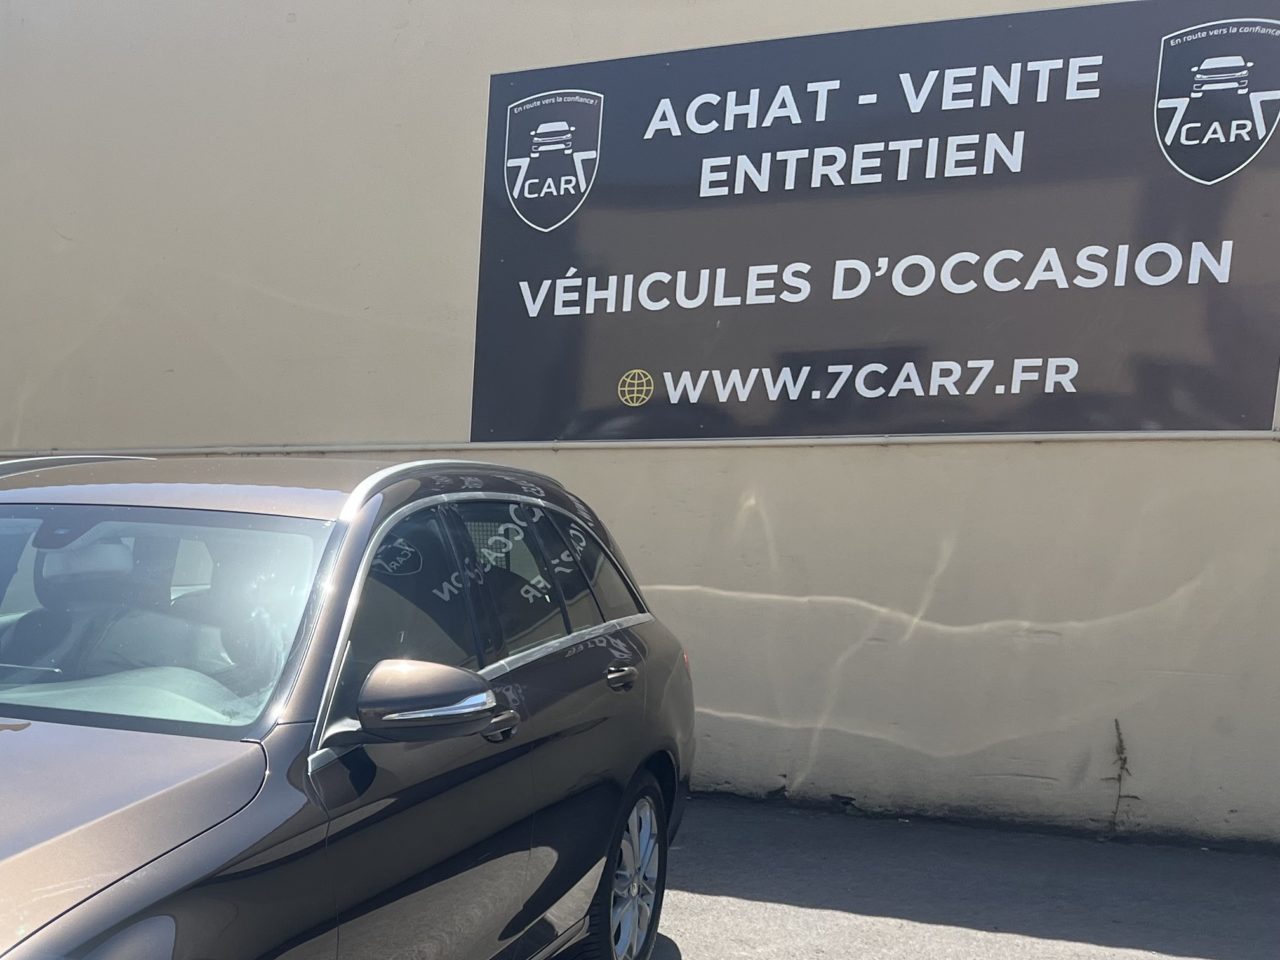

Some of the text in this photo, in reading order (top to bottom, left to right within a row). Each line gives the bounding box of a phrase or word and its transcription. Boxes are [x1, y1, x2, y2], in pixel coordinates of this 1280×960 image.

[1183, 31, 1207, 43] route
[1208, 27, 1228, 36] vers
[643, 55, 1103, 140] ACHAT - VENTE
[699, 130, 1025, 198] ENTRETIEN
[519, 262, 812, 318] VÉHICULES
[662, 357, 1079, 406] WWW.7CAR7.FR
